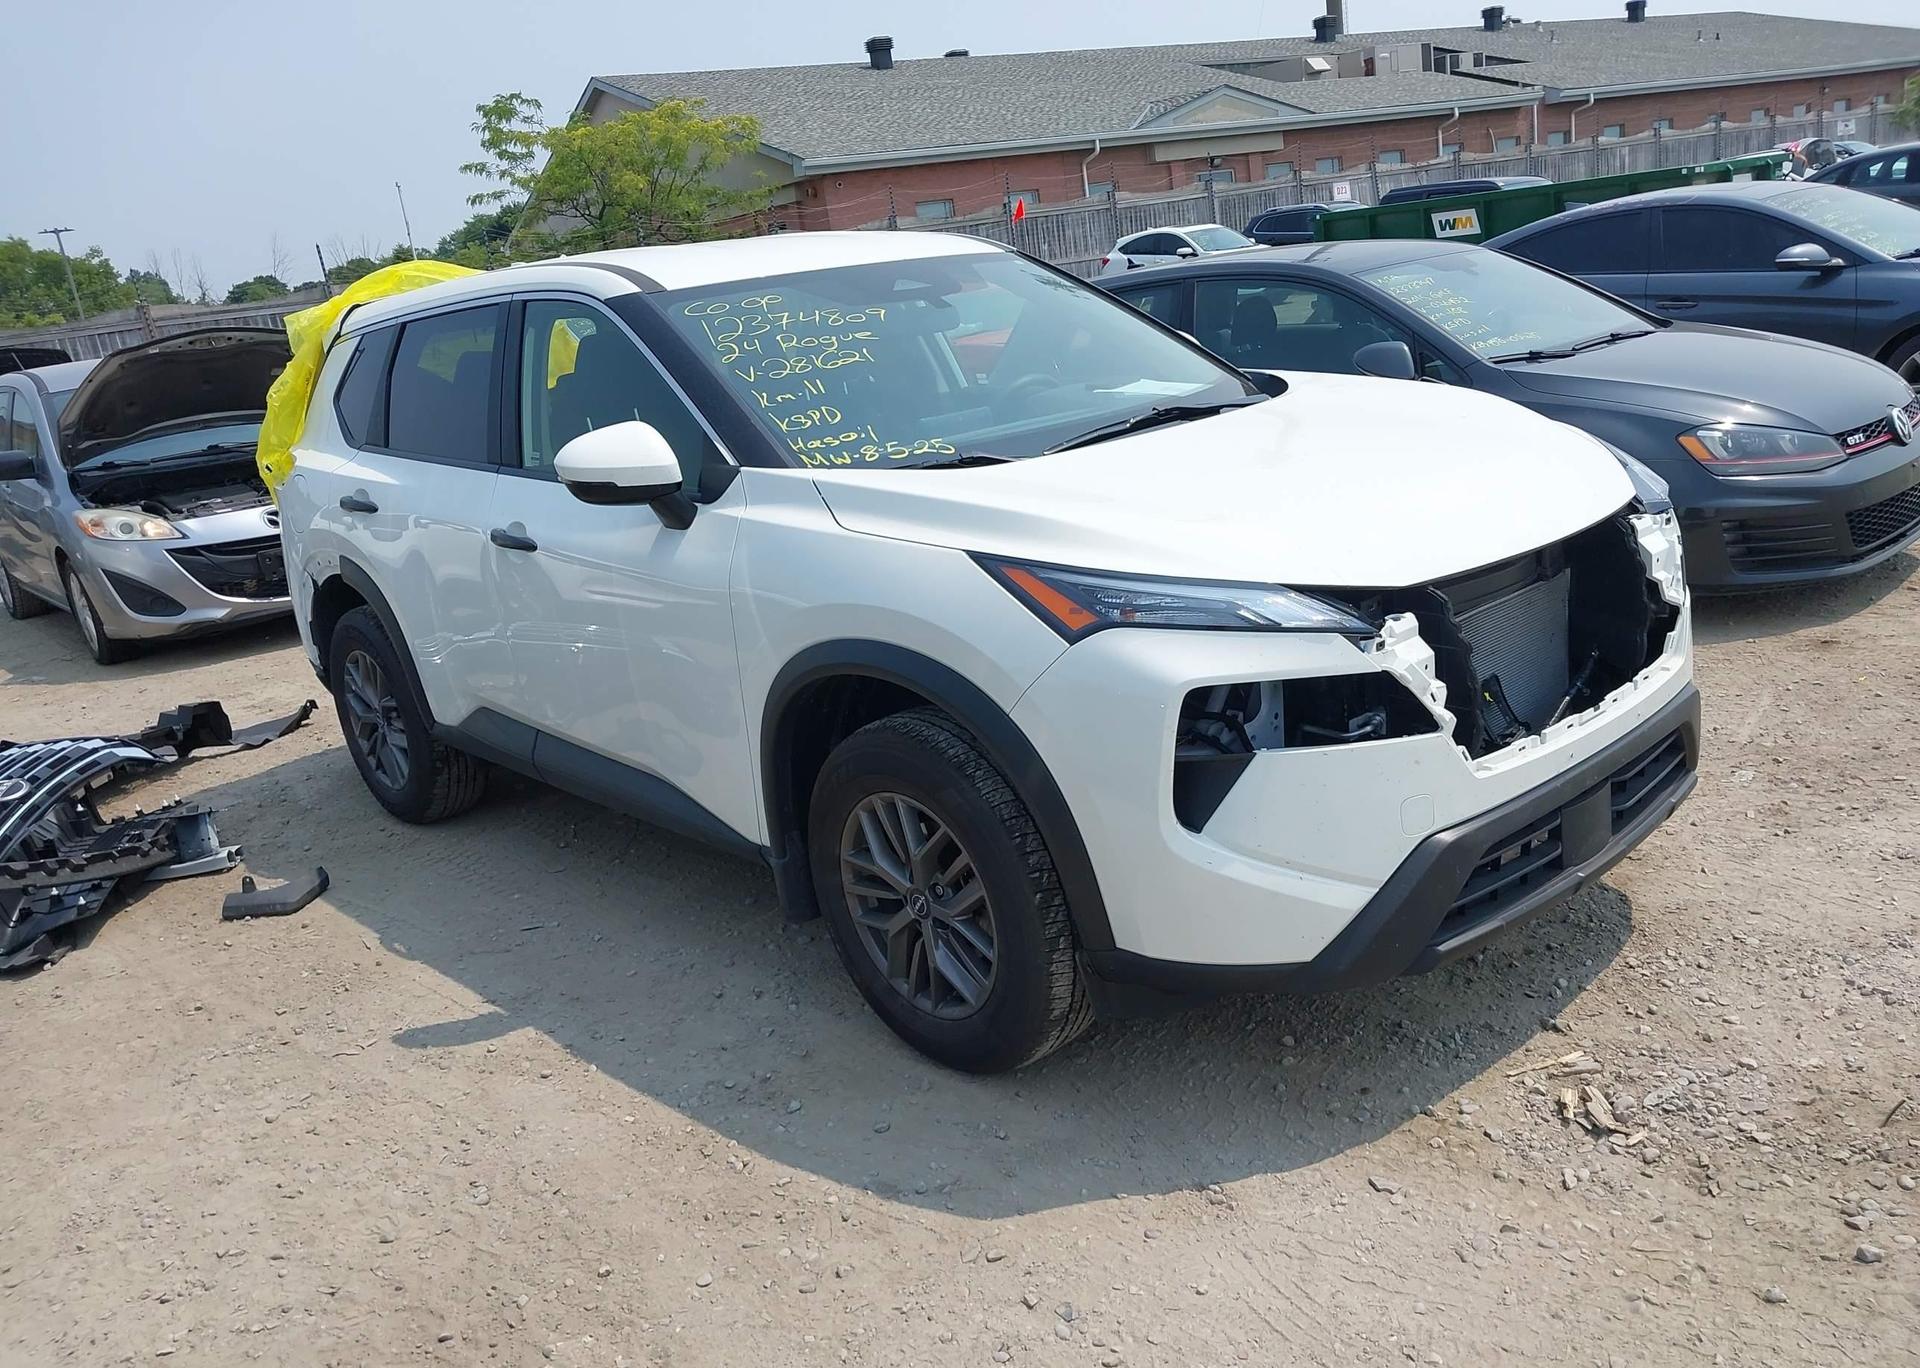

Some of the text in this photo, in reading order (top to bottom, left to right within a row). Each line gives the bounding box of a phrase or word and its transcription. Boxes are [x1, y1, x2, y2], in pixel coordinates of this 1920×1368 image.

[1438, 215, 1474, 232] WM
[775, 330, 880, 352] Rogue
[1847, 433, 1865, 445] GTI
